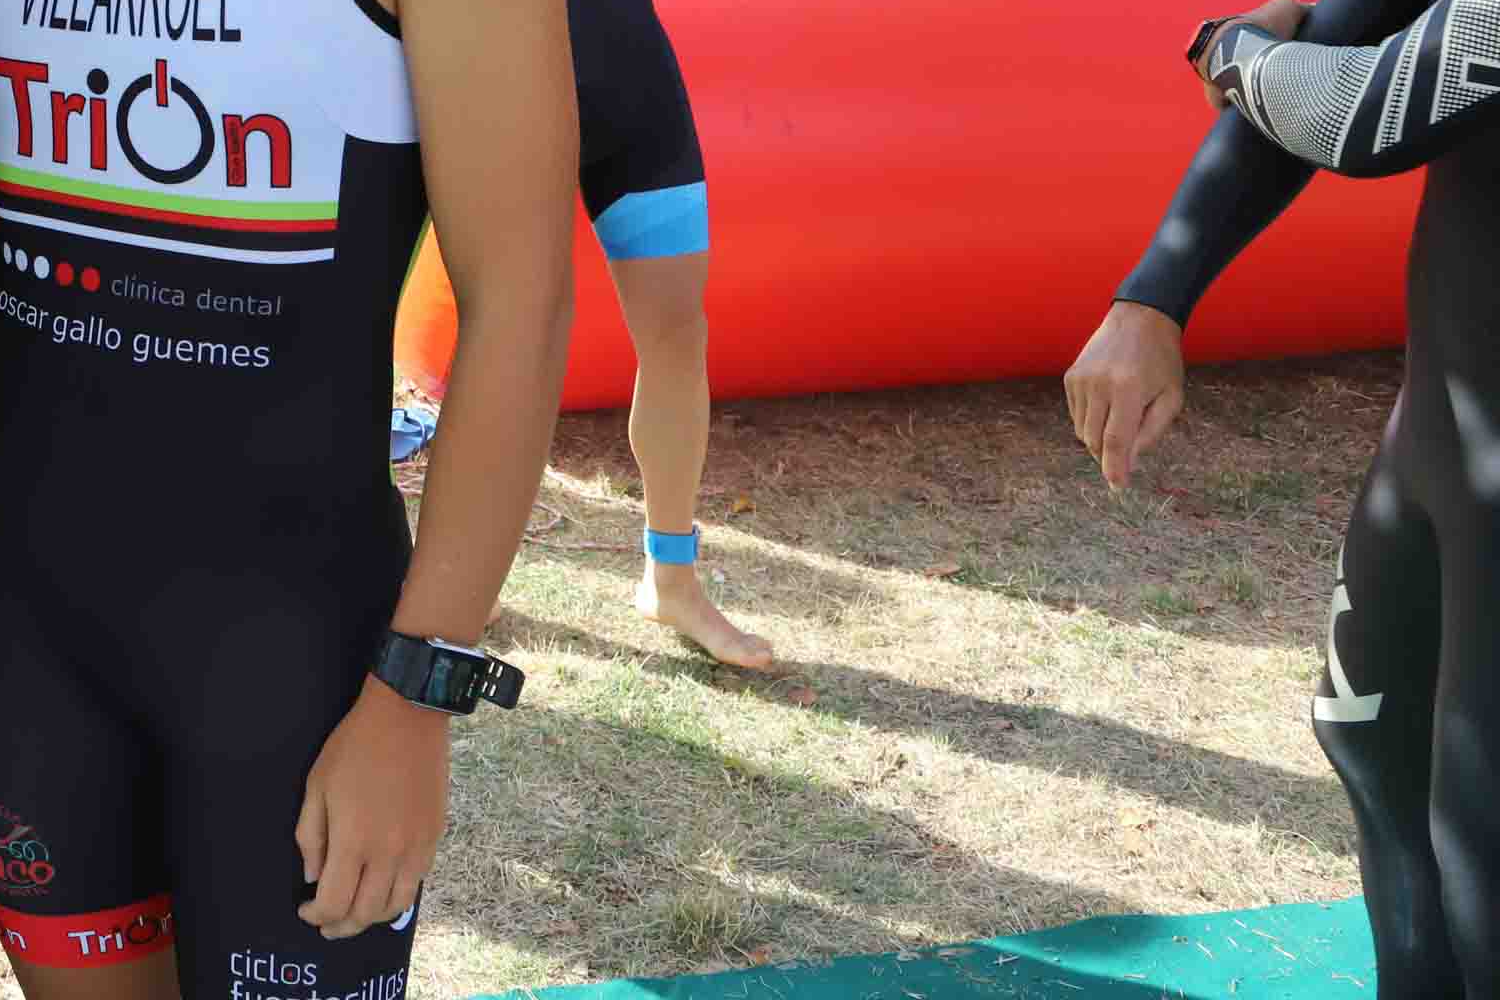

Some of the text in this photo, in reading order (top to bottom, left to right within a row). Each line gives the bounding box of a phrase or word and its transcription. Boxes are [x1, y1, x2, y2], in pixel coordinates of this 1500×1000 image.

[196, 287, 282, 316] dental
[52, 315, 122, 351] gallo
[133, 332, 270, 368] guemes
[230, 949, 317, 985] ciclos
